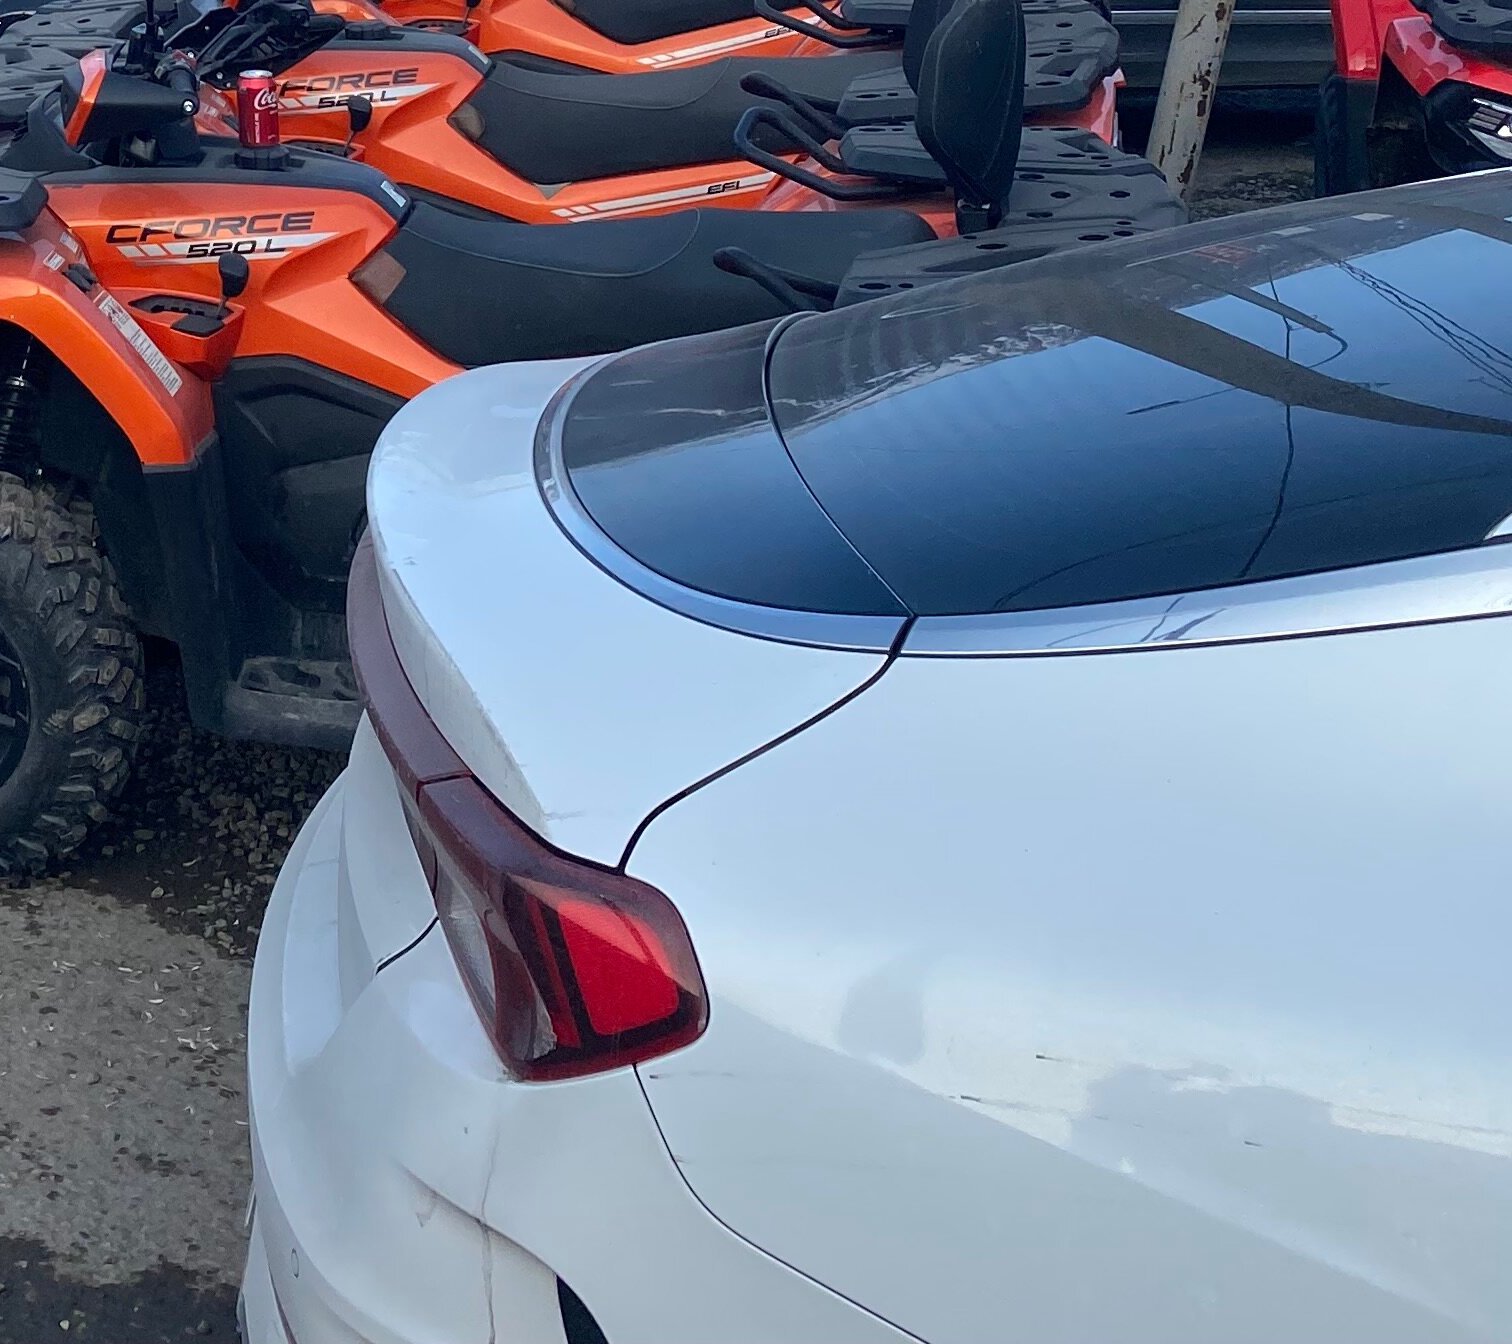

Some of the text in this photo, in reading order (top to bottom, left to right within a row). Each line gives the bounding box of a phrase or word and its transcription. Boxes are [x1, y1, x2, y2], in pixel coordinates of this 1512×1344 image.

[278, 67, 419, 98] FORCE
[105, 211, 315, 243] CFORCE
[186, 239, 257, 259] 520
